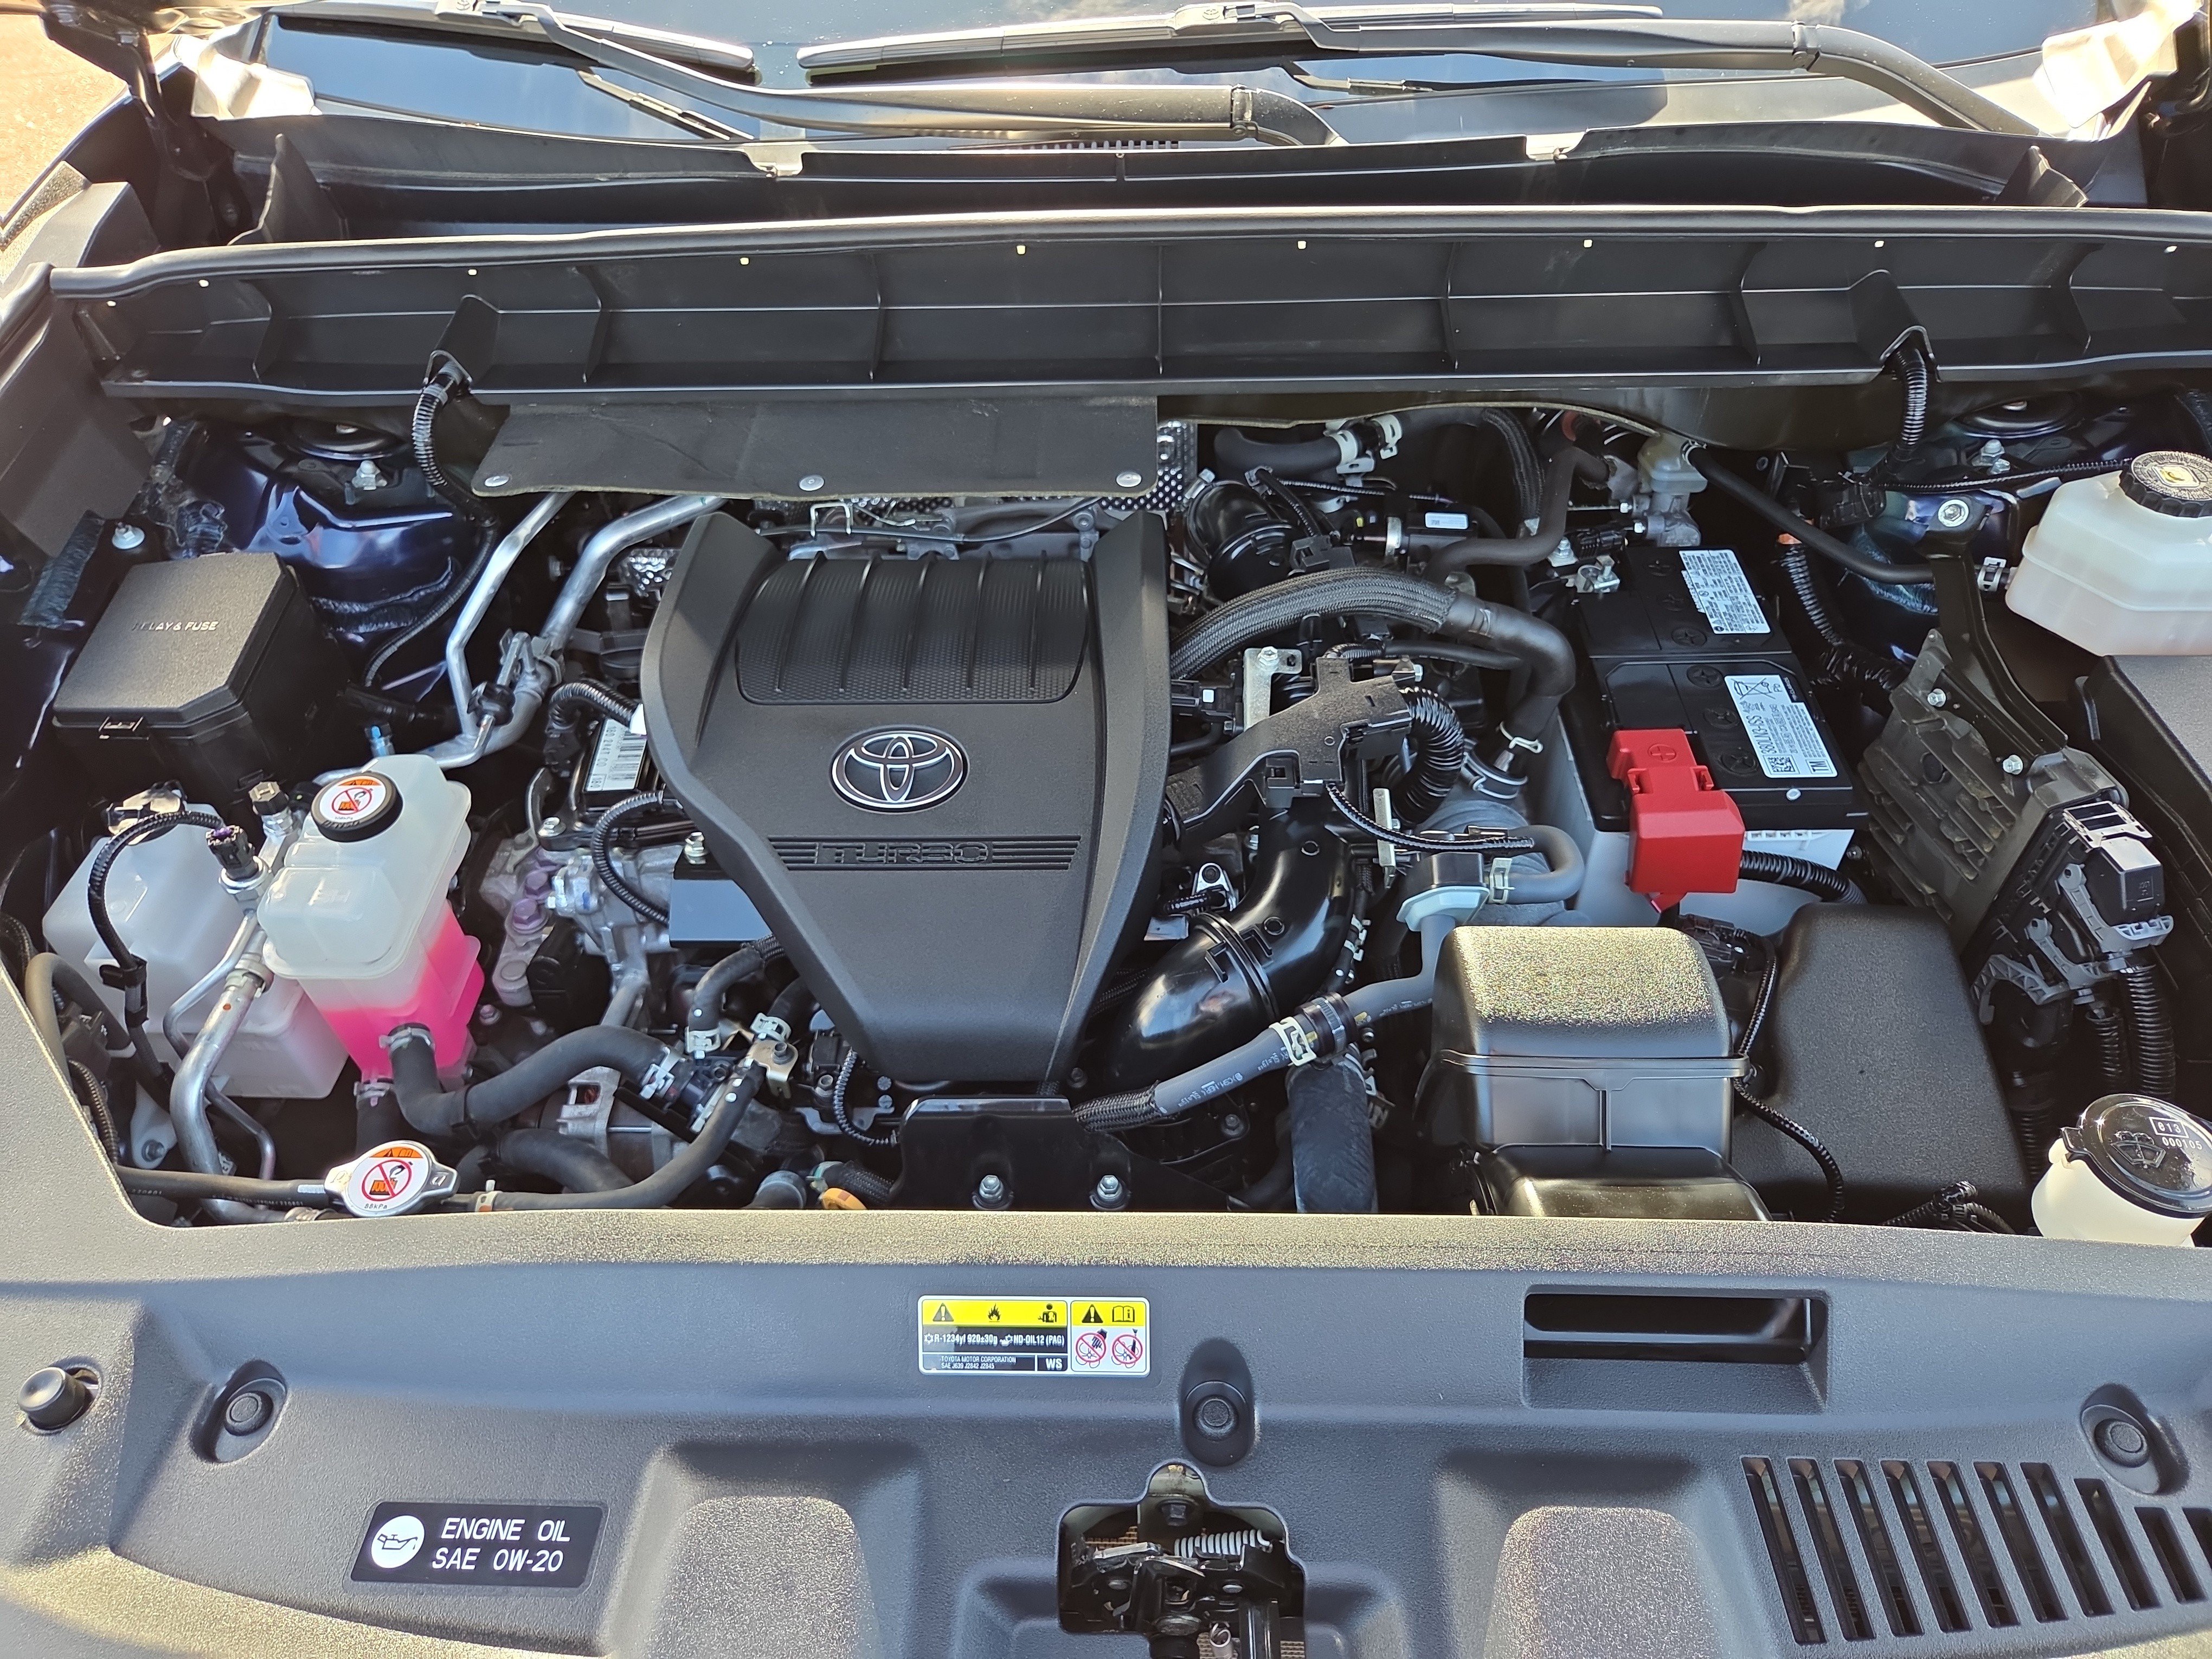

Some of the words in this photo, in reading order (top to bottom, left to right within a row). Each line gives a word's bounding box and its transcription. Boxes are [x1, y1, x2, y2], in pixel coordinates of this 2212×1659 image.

[185, 621, 219, 631] FUSE
[821, 841, 988, 864] TURBO
[2157, 1121, 2182, 1134] e13
[2162, 1136, 2203, 1150] 000105
[967, 1334, 998, 1346] 920±30g
[1013, 1334, 1045, 1345] ND-OIL12
[1045, 1334, 1065, 1346] (PAG)
[1046, 1358, 1063, 1369] WS
[441, 1517, 525, 1540] ENGINE
[537, 1520, 571, 1542] OIL
[432, 1548, 481, 1570] SAE
[493, 1549, 564, 1572] 0W-20
